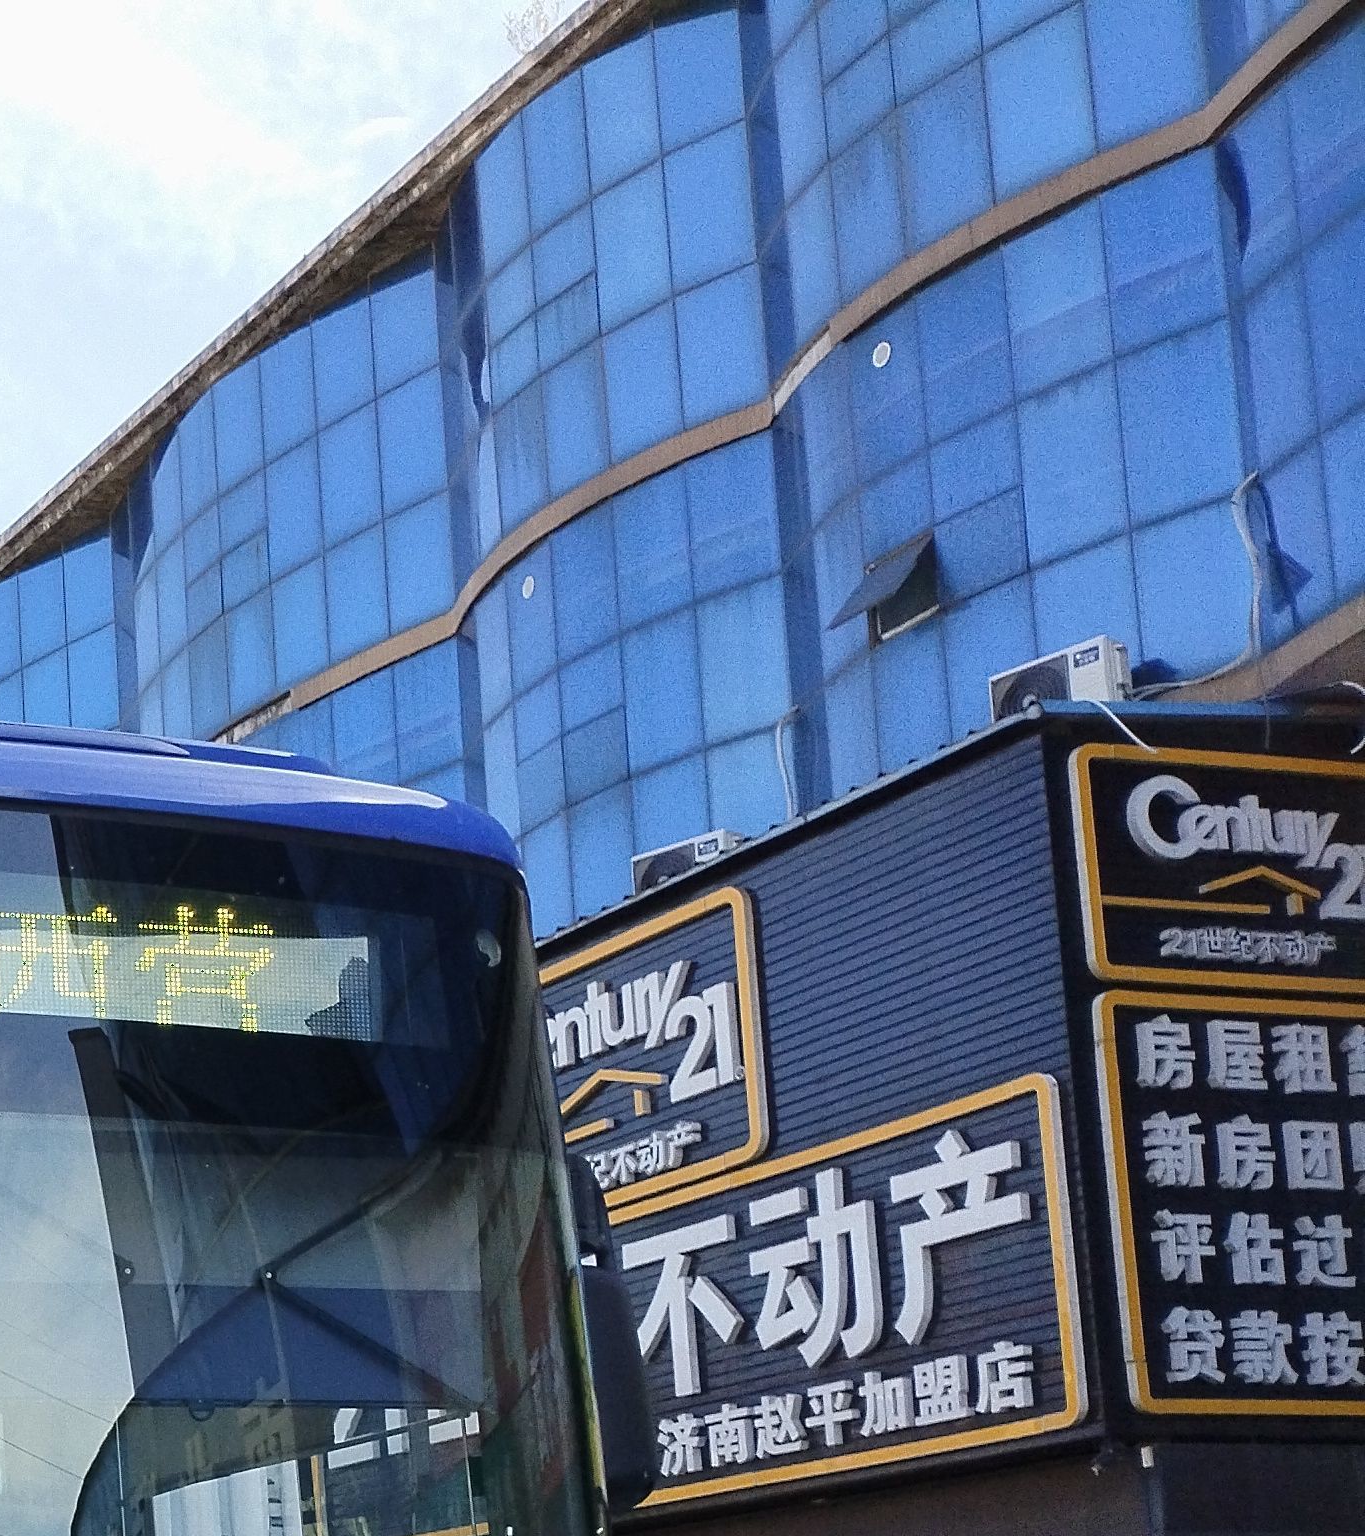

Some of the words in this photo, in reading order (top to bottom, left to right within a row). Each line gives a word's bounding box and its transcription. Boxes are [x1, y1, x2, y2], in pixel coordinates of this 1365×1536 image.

[1126, 774, 1340, 869] Century
[1158, 926, 1338, 966] 21世纪不动产
[546, 960, 692, 1069] ntury
[665, 980, 737, 1104] 21
[1142, 1110, 1365, 1193] 新房团
[622, 1129, 1031, 1398] 不动产
[657, 1340, 1035, 1477] 济南赵平加盟店
